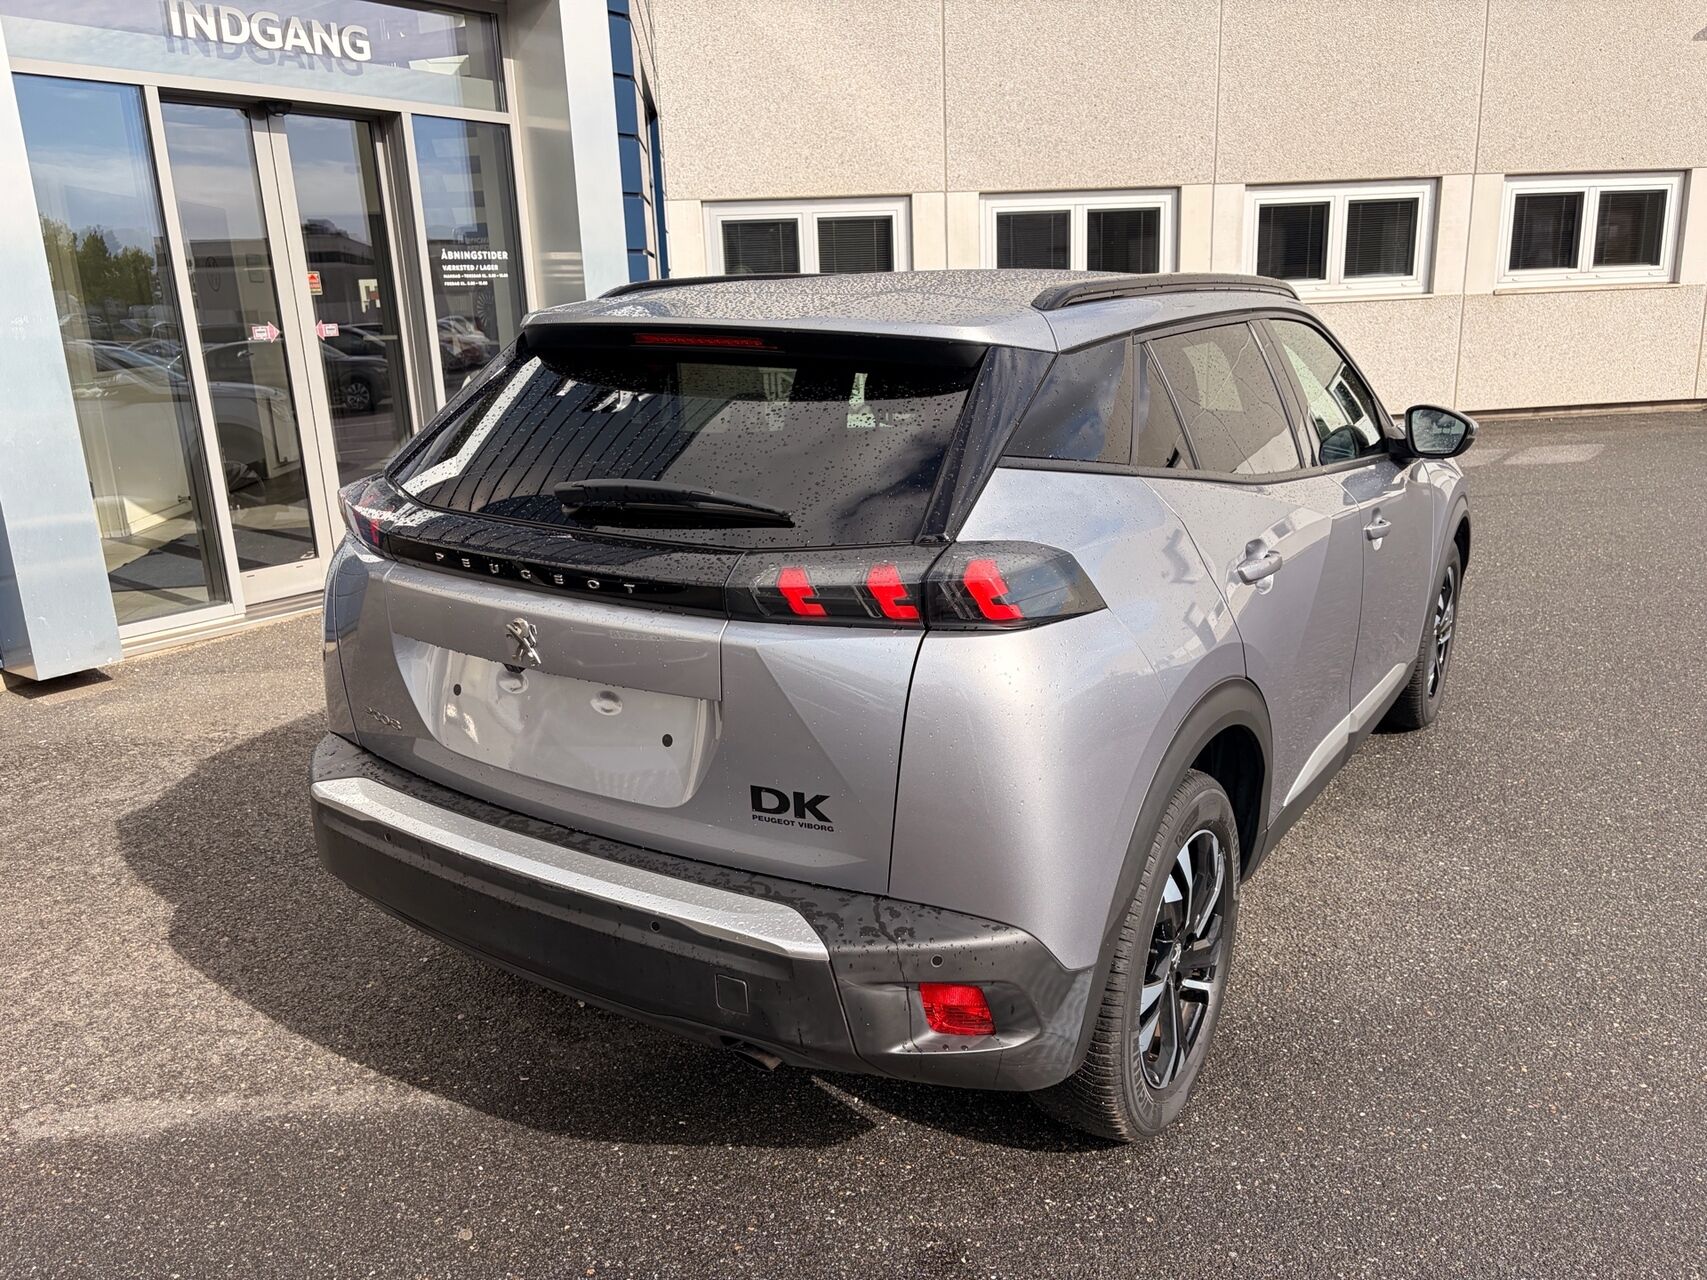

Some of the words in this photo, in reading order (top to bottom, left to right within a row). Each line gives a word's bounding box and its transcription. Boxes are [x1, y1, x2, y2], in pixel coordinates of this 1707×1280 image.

[169, 0, 372, 61] INDGANG
[441, 248, 508, 260] ÅBNINGSTIDER
[434, 551, 636, 594] PEUGEOT
[750, 785, 833, 823] DK
[752, 814, 796, 827] PEUGEOT
[798, 821, 835, 832] VIBORG
